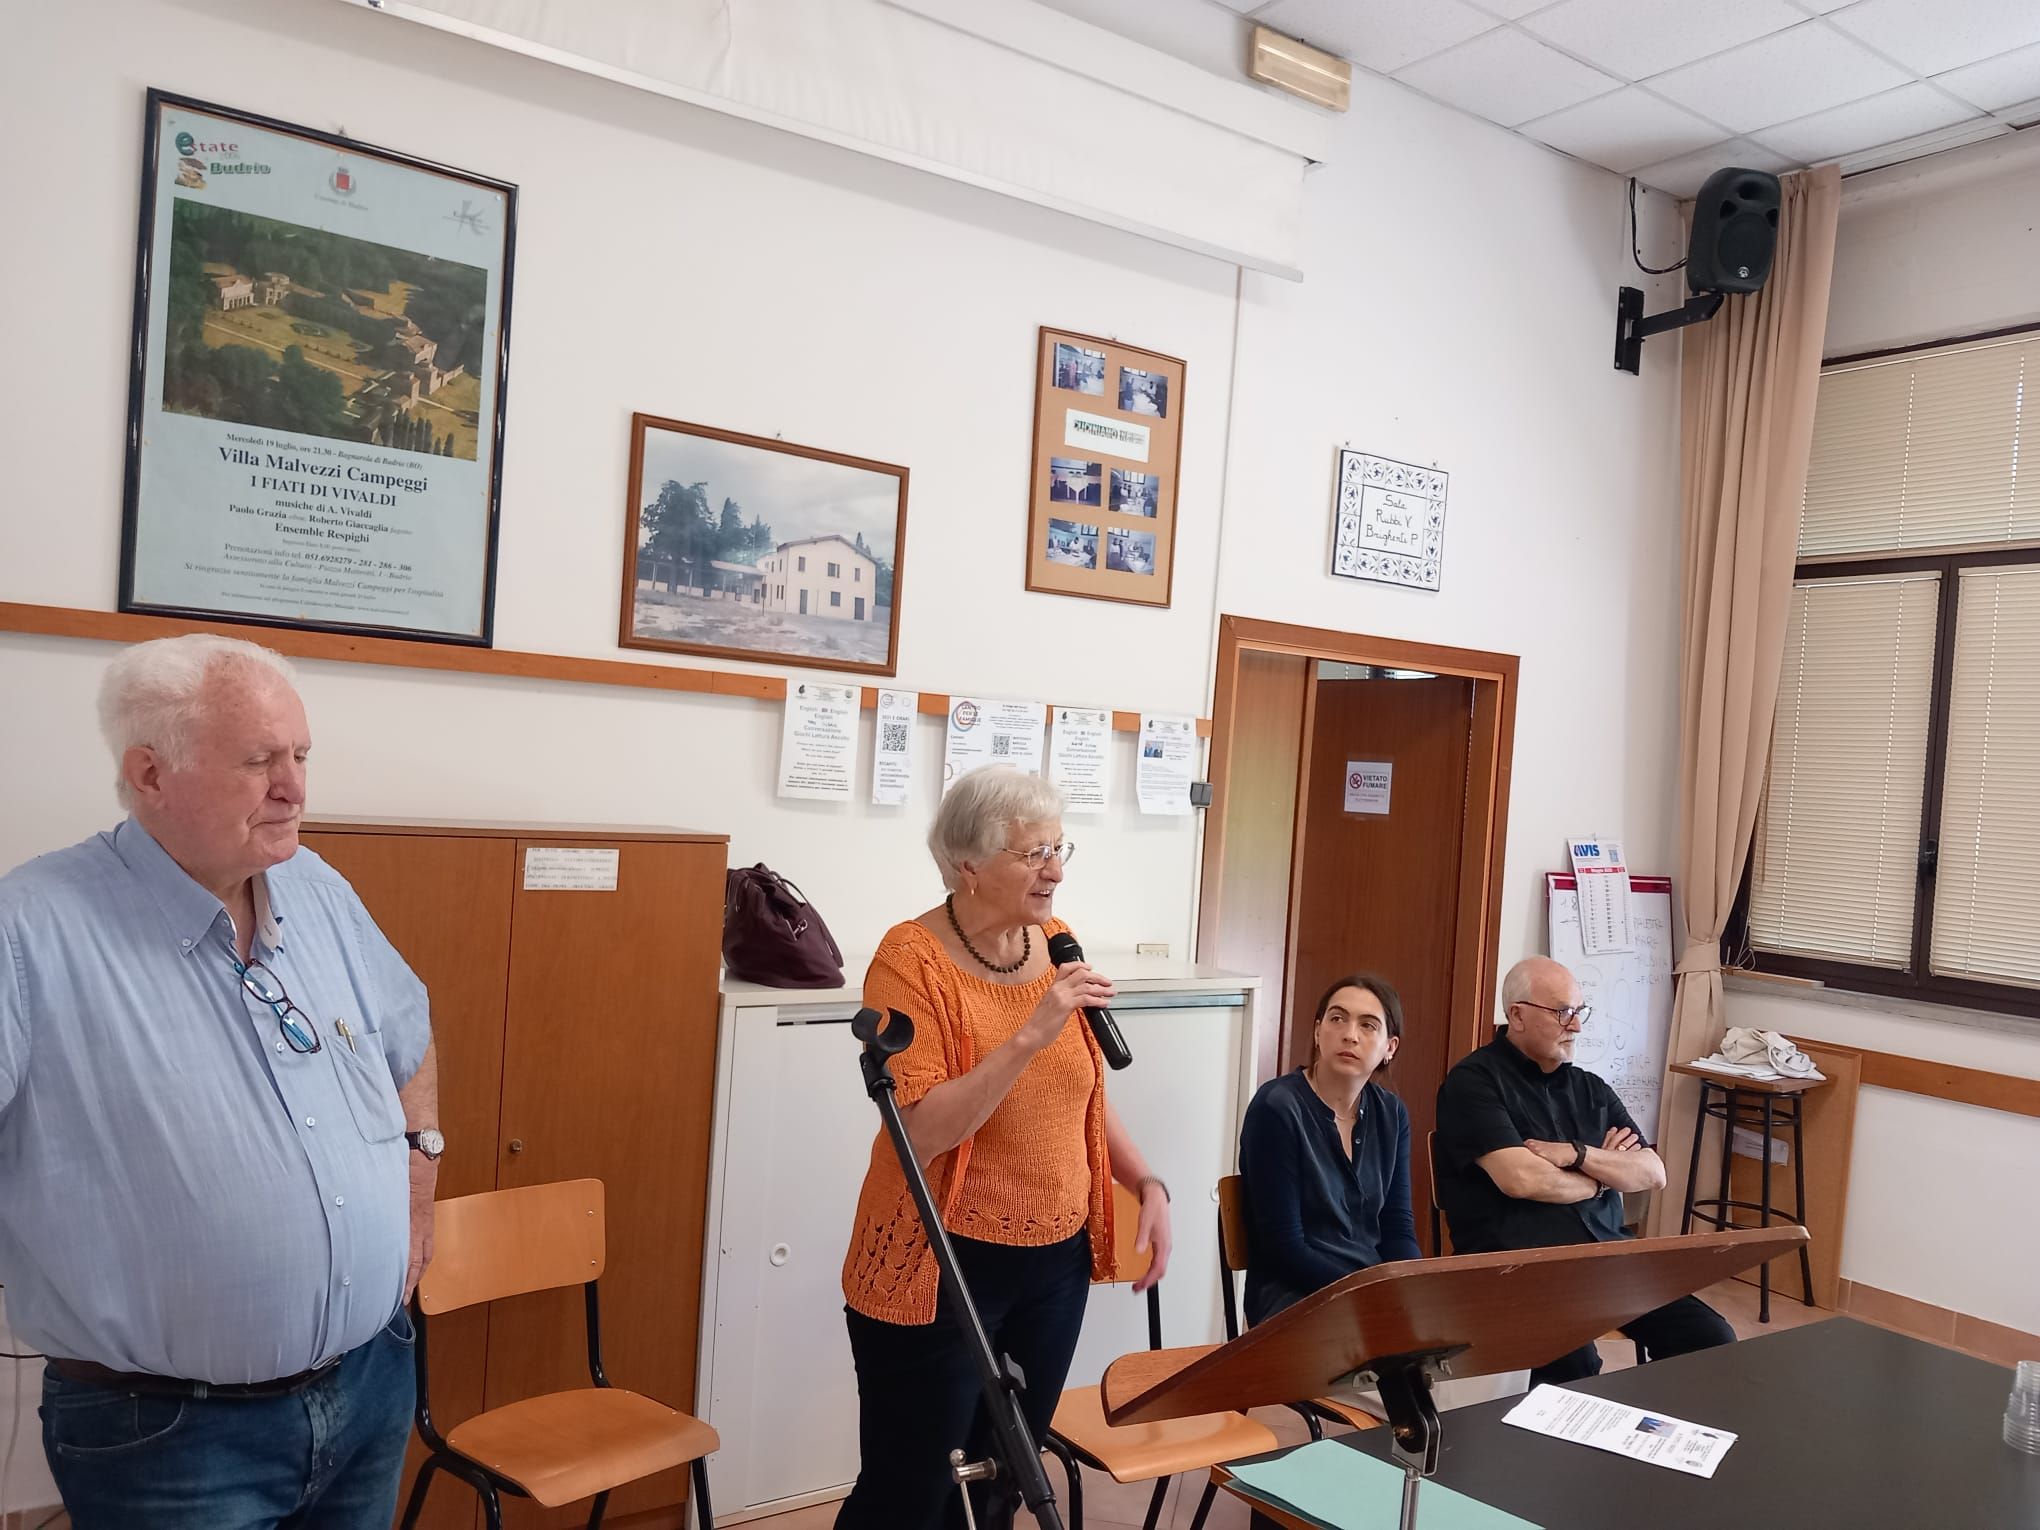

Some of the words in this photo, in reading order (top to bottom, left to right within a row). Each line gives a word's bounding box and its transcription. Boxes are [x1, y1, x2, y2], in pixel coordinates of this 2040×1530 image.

[175, 131, 239, 156] estate
[210, 162, 271, 175] Budrio
[219, 446, 260, 467] Villa
[266, 454, 341, 478] Malvezzi
[347, 466, 428, 494] Campeggi
[251, 475, 256, 487] I
[262, 476, 306, 494] FIATI
[310, 483, 328, 497] DI
[332, 486, 397, 507] VIVALDI
[229, 504, 255, 515] Paolo
[256, 508, 287, 519] Grazia
[309, 514, 344, 526] Roberto
[345, 519, 389, 533] Giaccaglia
[275, 500, 314, 511] musiche
[316, 503, 326, 513] di
[327, 505, 338, 514] A.
[340, 506, 373, 519] Vivaldi
[275, 522, 325, 538] Ensemble
[327, 529, 370, 543] Respighi
[1362, 774, 1388, 782] VIETATO
[1362, 782, 1387, 790] FUMARE
[1574, 844, 1600, 857] AVIS
